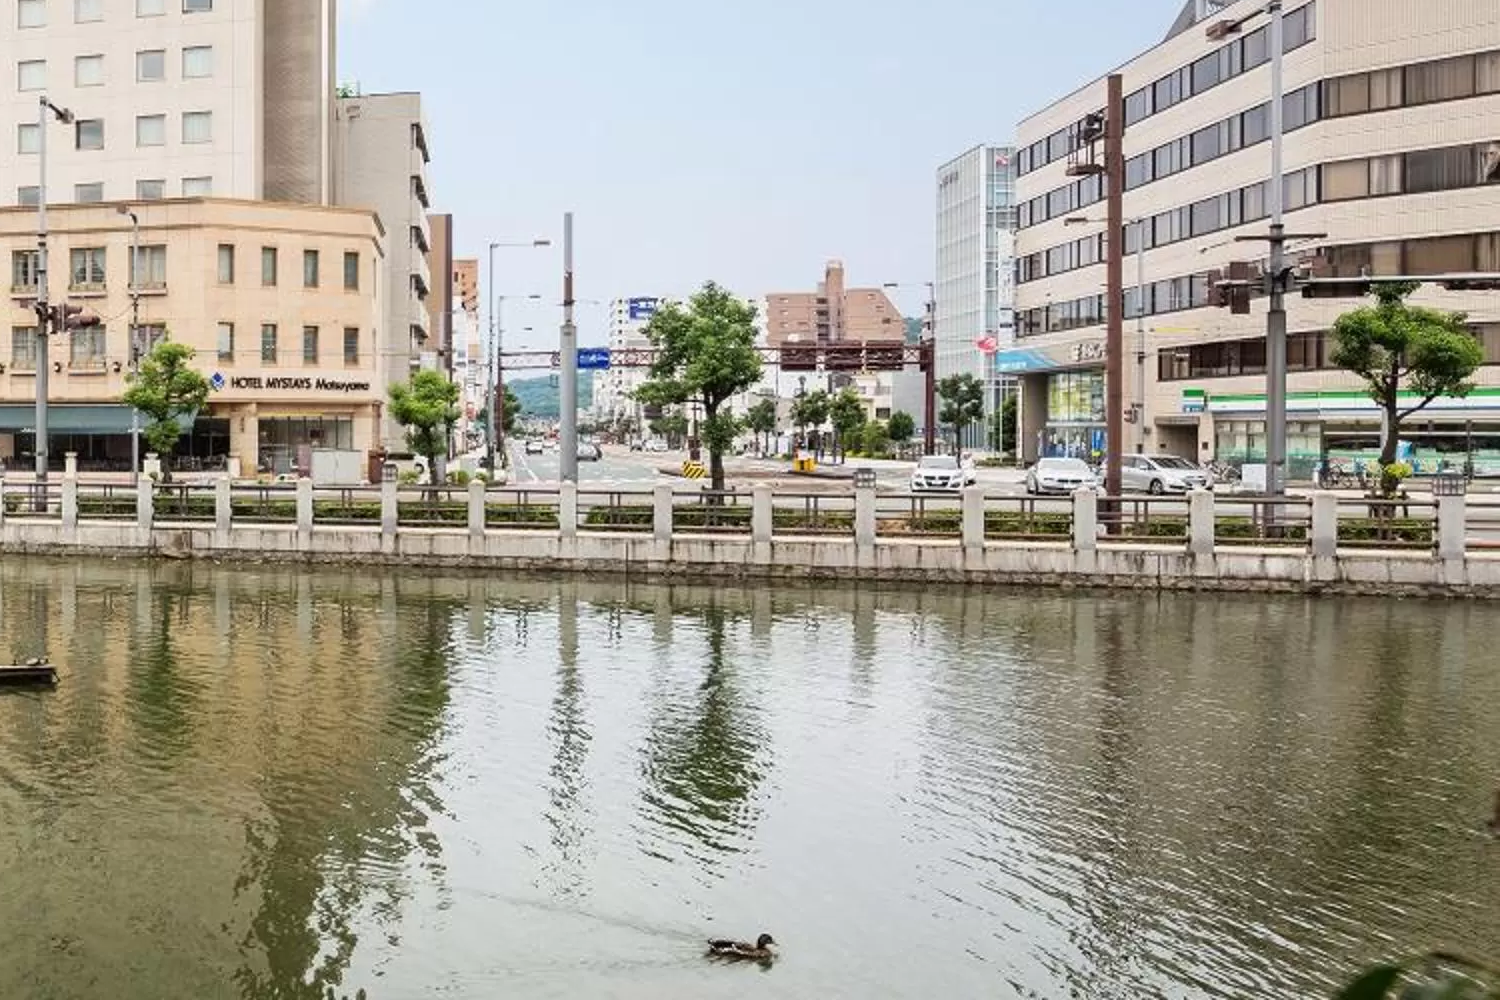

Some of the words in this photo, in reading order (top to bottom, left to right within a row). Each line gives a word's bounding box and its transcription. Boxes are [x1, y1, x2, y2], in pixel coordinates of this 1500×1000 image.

[231, 376, 263, 389] HOTEL
[265, 377, 312, 389] MYSTAYS
[315, 378, 371, 393] Matsuyama
